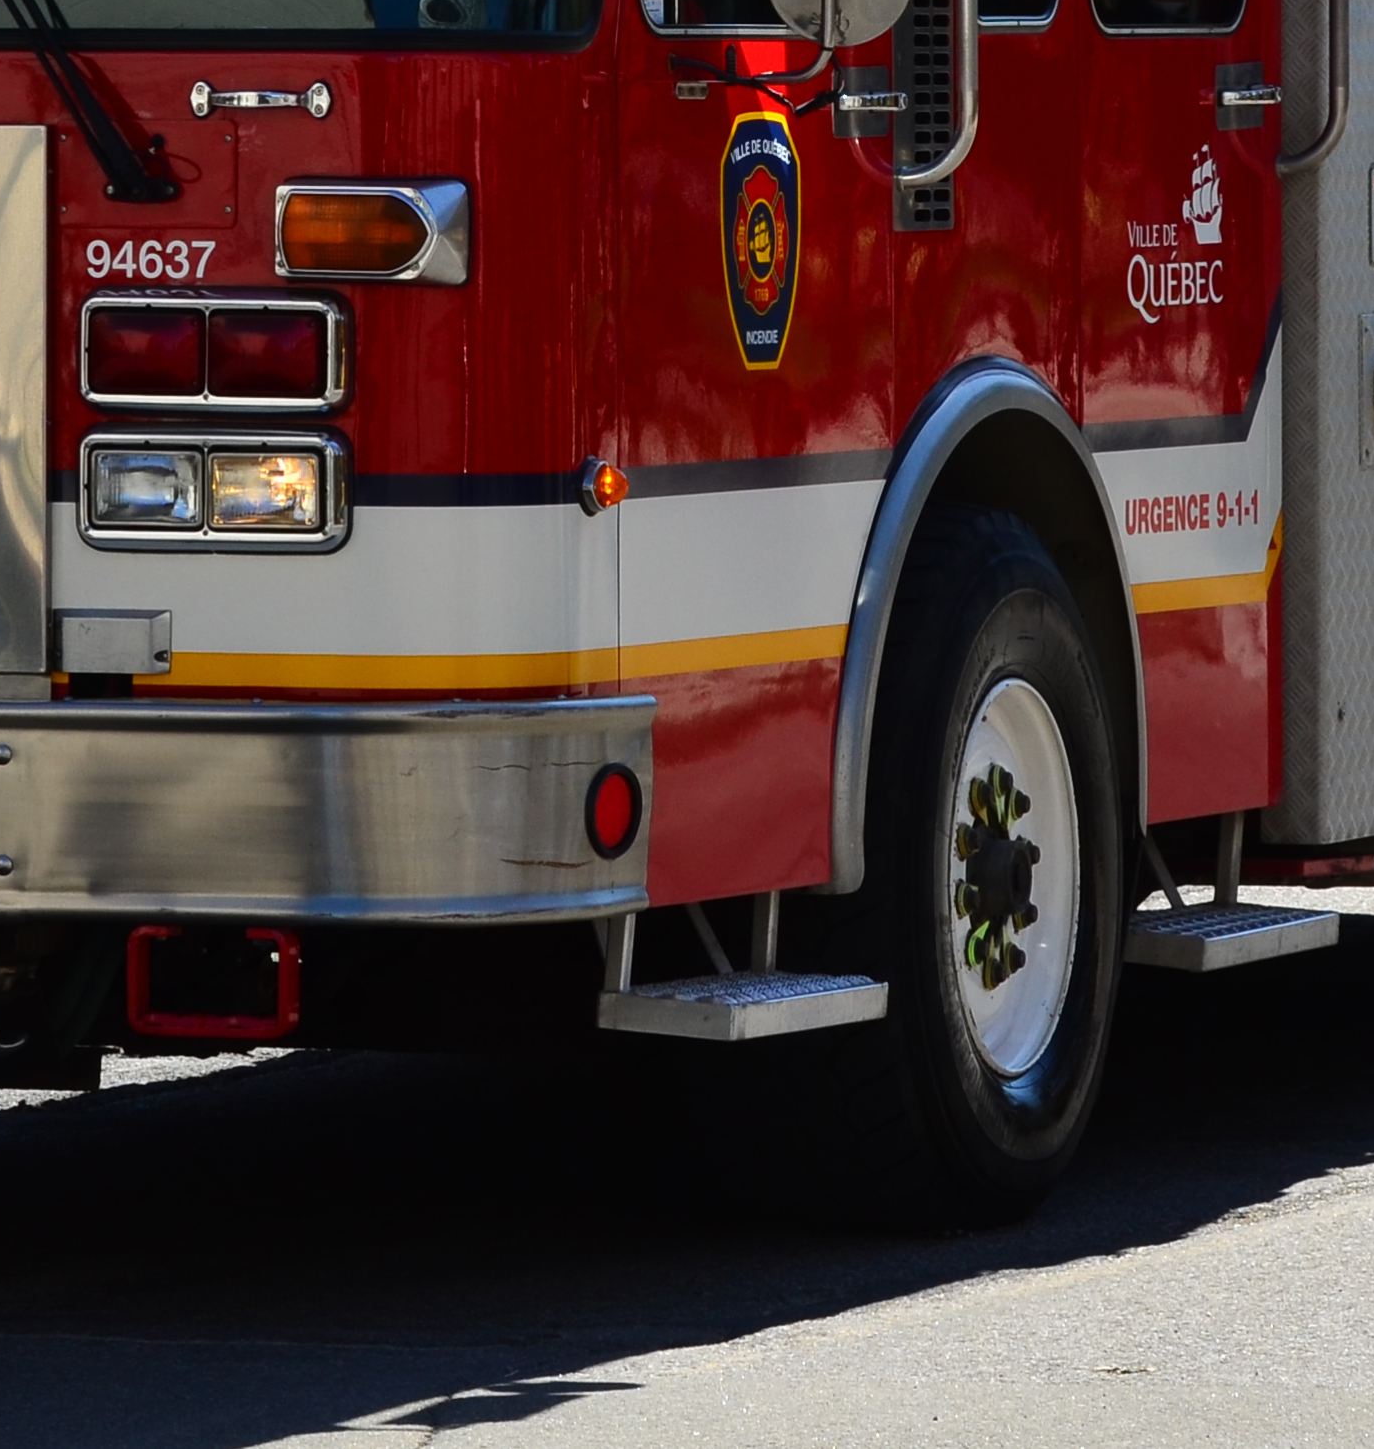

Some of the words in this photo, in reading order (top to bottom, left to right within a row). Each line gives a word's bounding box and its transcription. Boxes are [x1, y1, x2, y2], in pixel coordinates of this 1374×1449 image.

[730, 141, 750, 165] VILLE
[751, 139, 762, 154] DE
[763, 137, 792, 165] QUÉBEC
[1127, 221, 1160, 248] VILLE
[1163, 223, 1178, 247] DE
[86, 239, 216, 279] 94637
[1127, 251, 1224, 324] QUÉBEC
[746, 329, 778, 345] INCENDIE
[1125, 494, 1211, 536] URGENCE
[1216, 488, 1258, 529] 9-1-1
